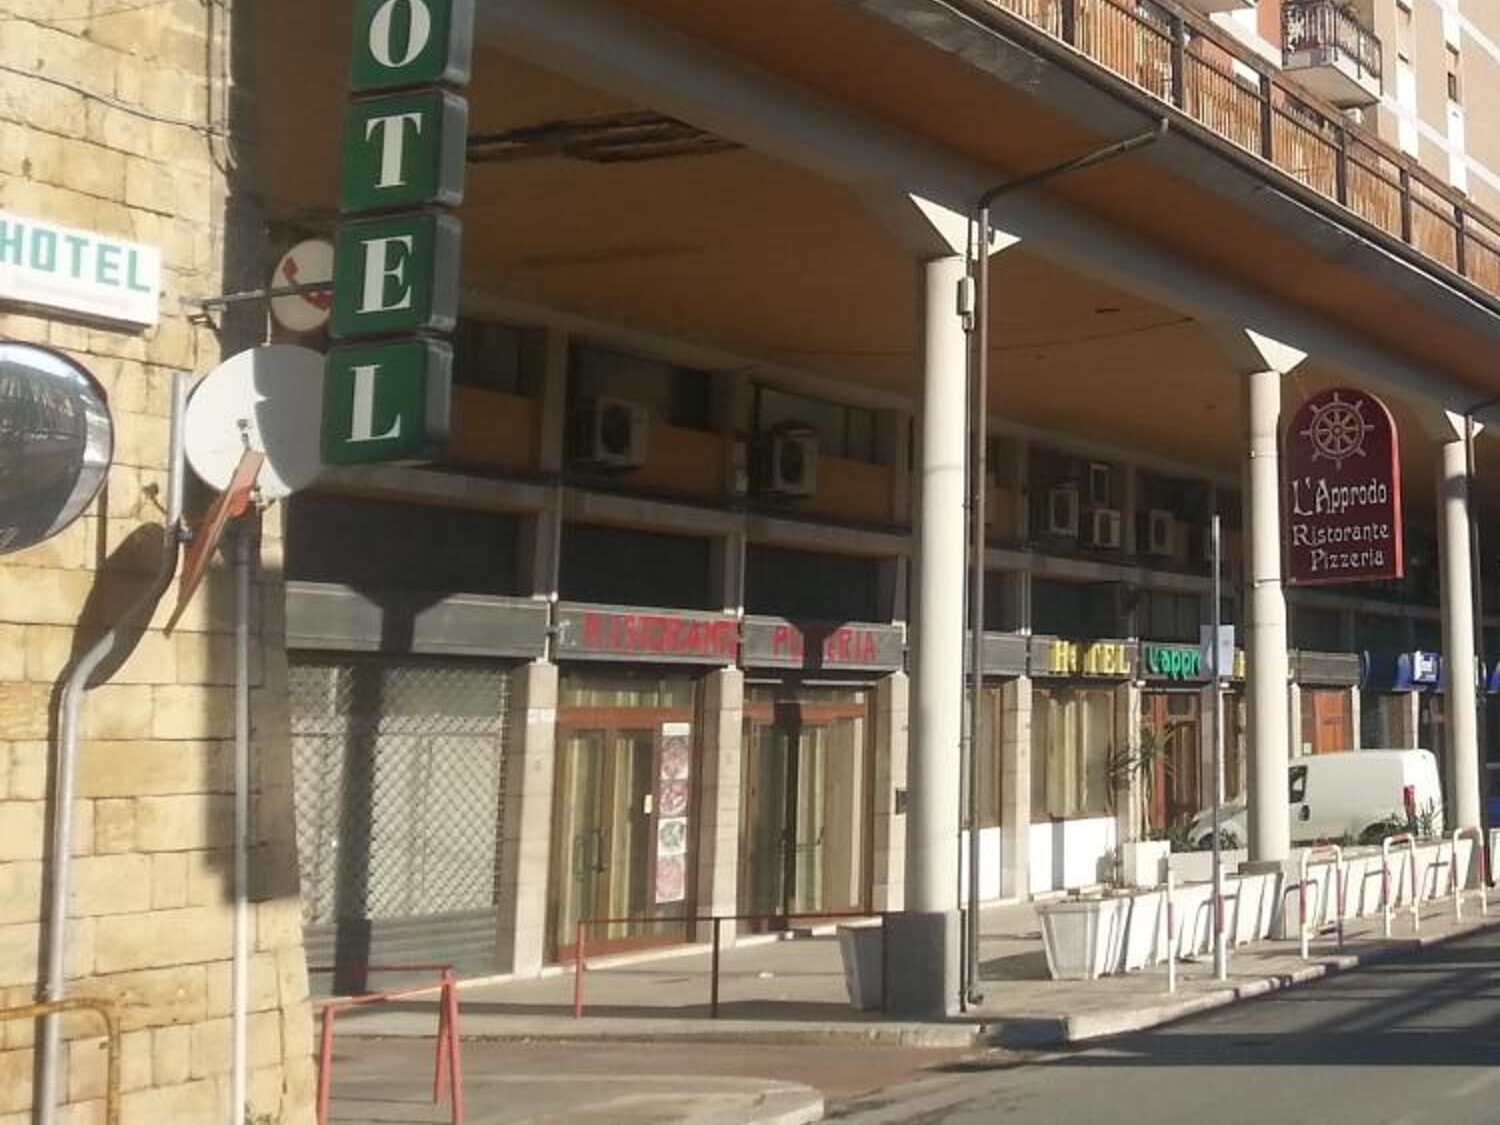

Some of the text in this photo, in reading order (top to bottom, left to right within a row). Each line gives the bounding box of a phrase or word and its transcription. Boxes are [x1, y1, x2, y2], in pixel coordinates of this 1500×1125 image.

[0, 220, 151, 294] HOTEL
[1292, 476, 1388, 517] L'Approdo
[1293, 523, 1389, 547] Ristorante
[1310, 548, 1385, 572] Pizzeria
